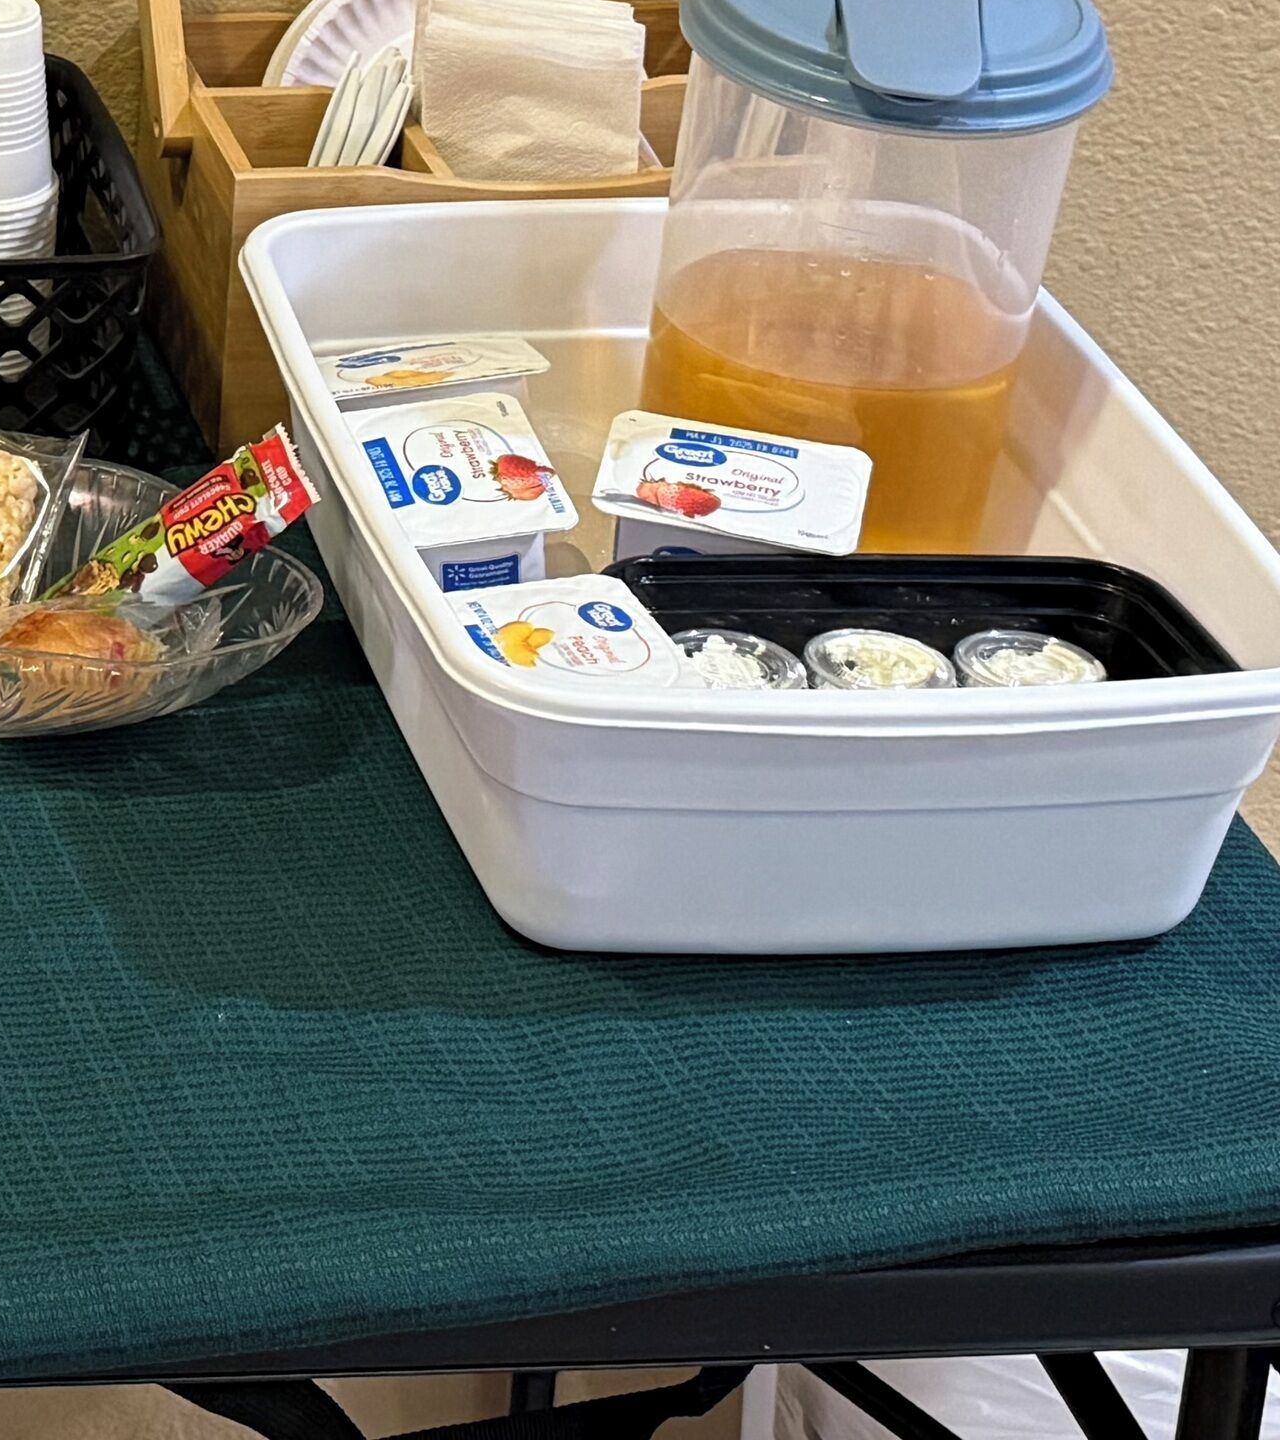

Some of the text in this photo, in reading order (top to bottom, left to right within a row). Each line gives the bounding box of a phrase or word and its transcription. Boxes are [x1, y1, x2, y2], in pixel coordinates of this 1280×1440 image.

[452, 429, 487, 480] Strawberry
[663, 444, 716, 460] Great
[420, 471, 446, 502] Great
[685, 471, 782, 498] Strawberry
[730, 468, 786, 486] Original
[198, 518, 244, 556] QUAKER
[592, 603, 625, 628] Great
[568, 635, 598, 665] Peach
